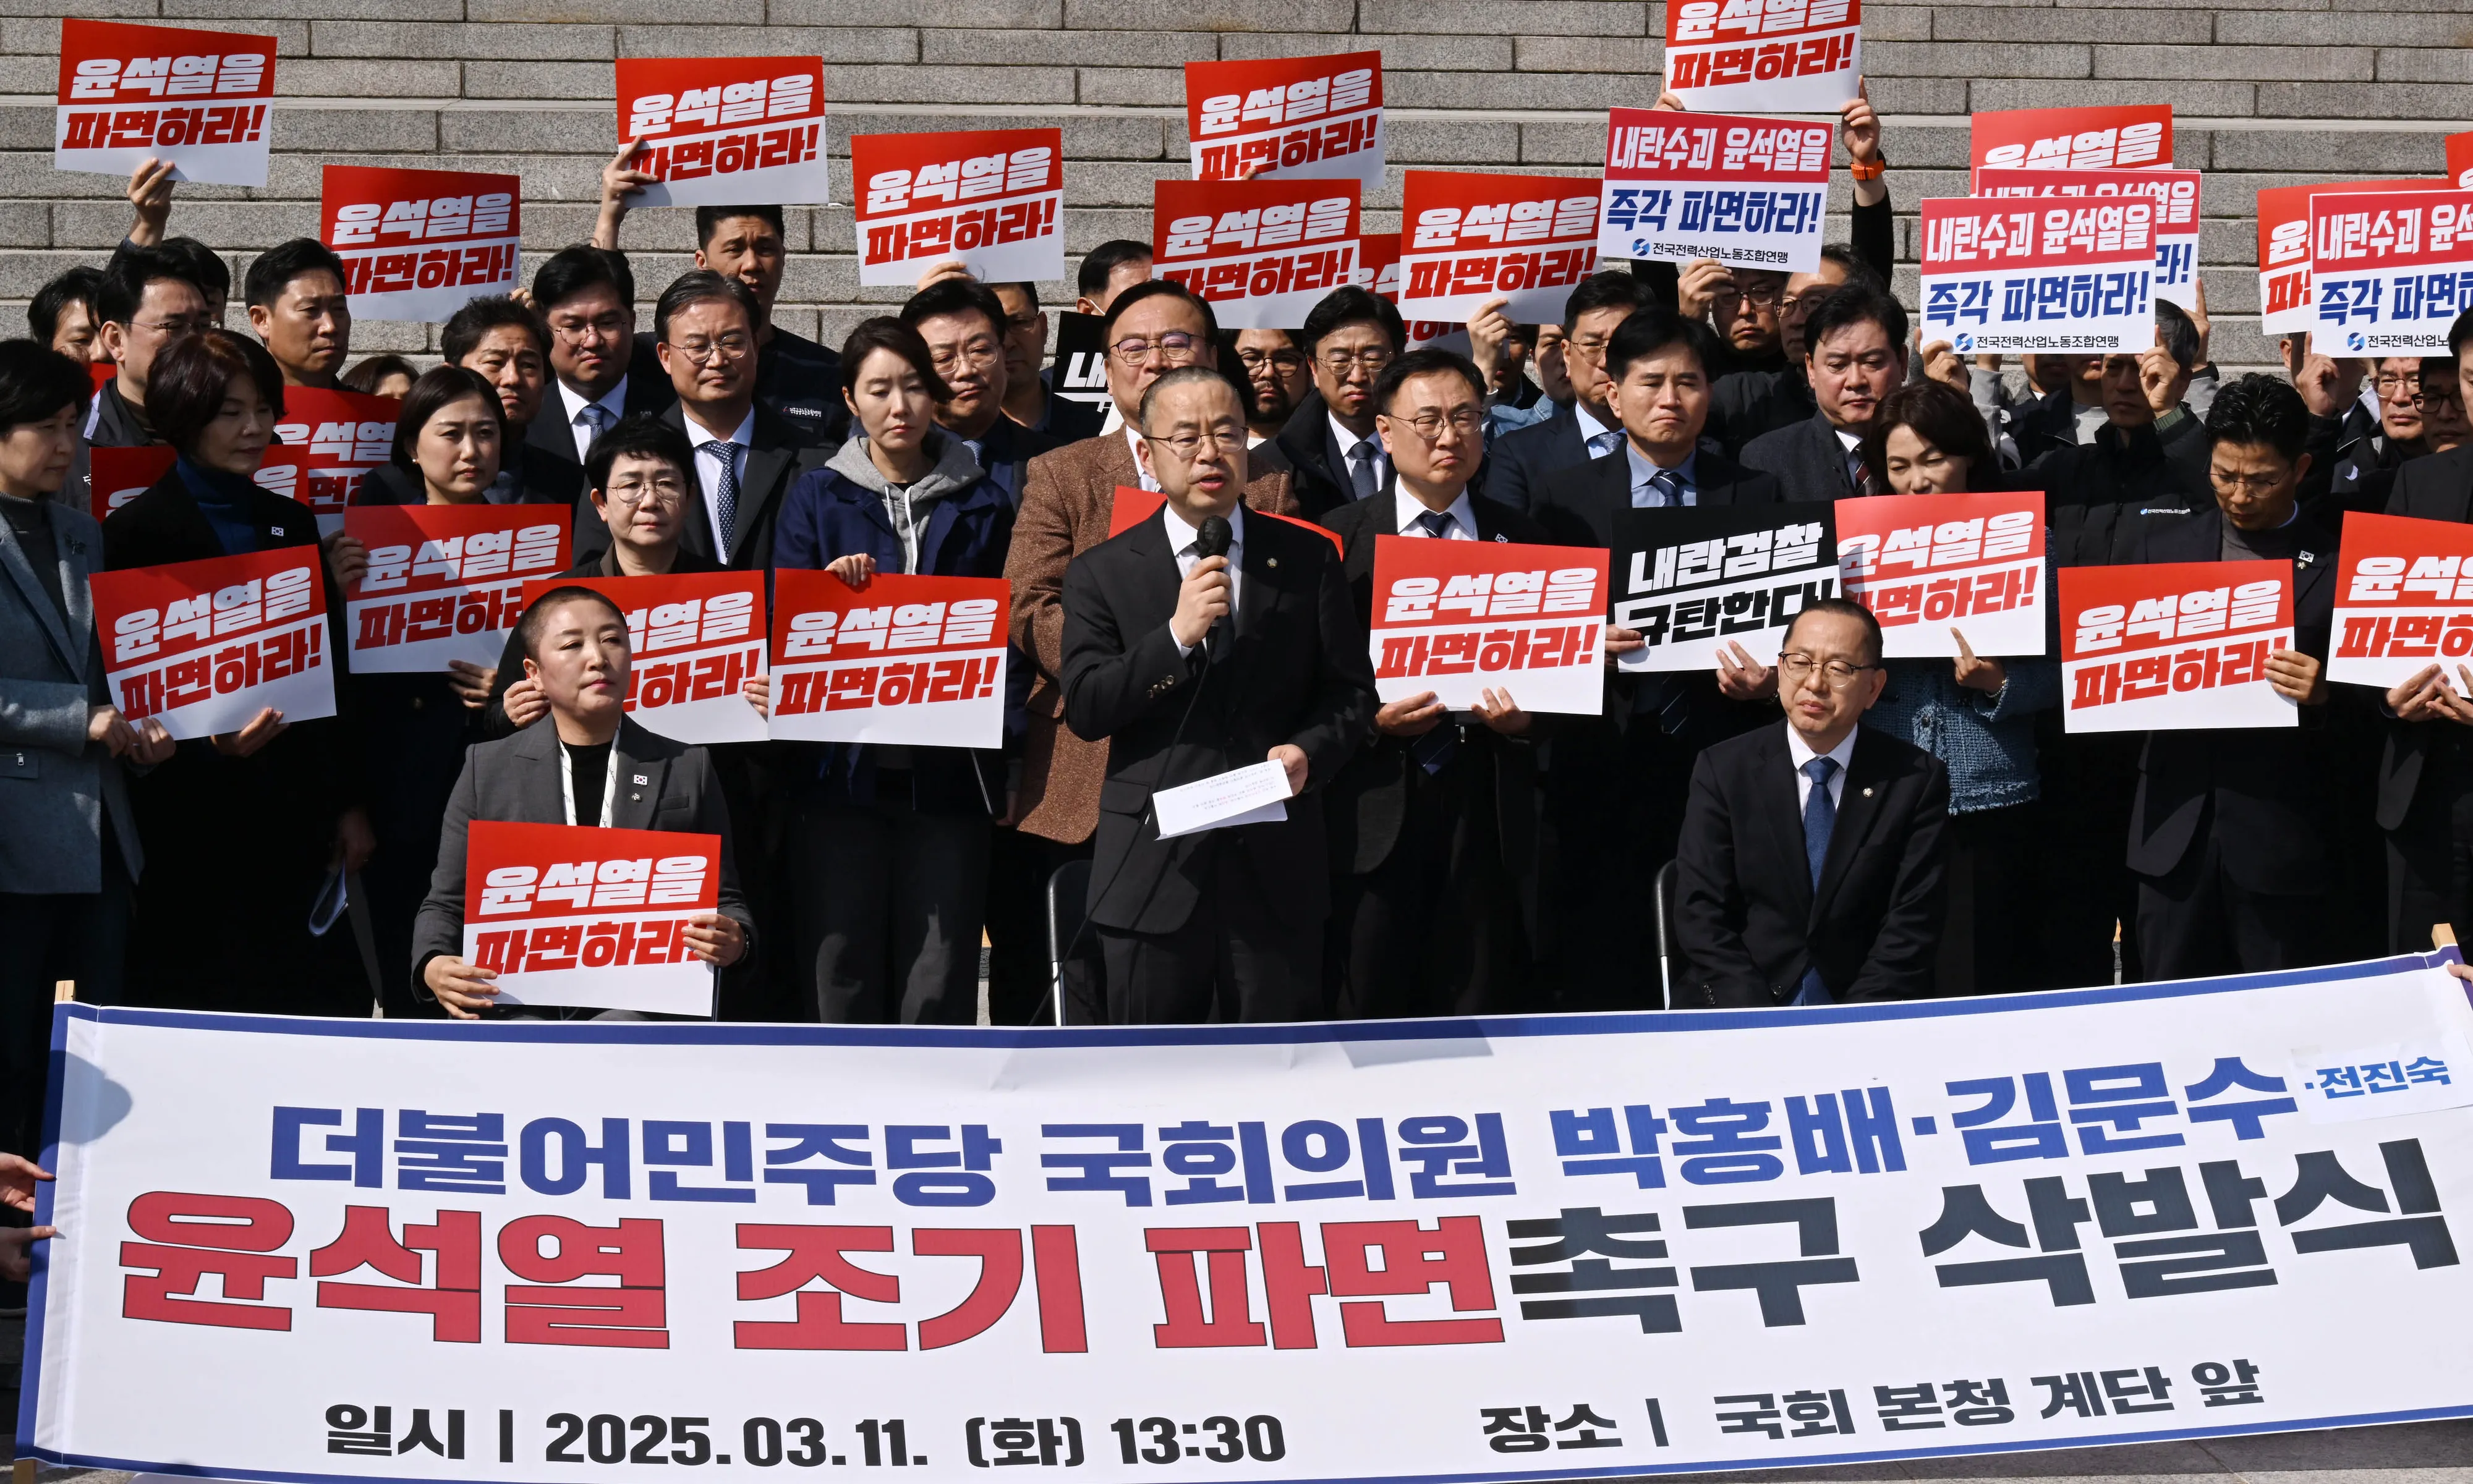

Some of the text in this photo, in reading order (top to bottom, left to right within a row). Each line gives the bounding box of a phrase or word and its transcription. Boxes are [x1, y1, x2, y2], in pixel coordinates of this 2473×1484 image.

[70, 54, 266, 99] 윤석열을
[1670, 33, 1855, 89] 파면하라!
[62, 104, 266, 150] 파면하라!
[629, 74, 814, 137] 윤석열을
[1199, 68, 1373, 135] 윤석열을
[631, 124, 819, 182] 파면하라!
[1199, 114, 1377, 180] 파면하라!
[1611, 125, 1828, 172] 내란수괴 윤석열을
[866, 146, 1052, 214] 윤석열을
[2095, 180, 2195, 223] 열을
[331, 193, 513, 245] 윤석열을
[865, 197, 1057, 266] 파면하라!
[1164, 197, 1351, 257] 윤석열을
[1413, 196, 1599, 248] 윤석열을
[1607, 189, 1821, 235] 즉각 파면하라!
[1926, 204, 2151, 262] 내란수괴 윤석열을
[2317, 208, 2422, 260] 내란수괴
[2430, 204, 2473, 251] 윤석
[1404, 248, 1594, 299] 파면하라!
[1653, 242, 1789, 263] 전국전력산업노동조합연맹
[1926, 271, 2149, 327] 즉각 파면하라!
[2319, 278, 2383, 326] 즉각
[1976, 335, 2119, 349] 전국전력산업노동조합연맹
[2368, 334, 2448, 347] 전국전력산업노
[273, 422, 396, 461] 석열
[360, 524, 560, 592] 윤석열을
[1627, 522, 1823, 595] 내란검찰
[1837, 511, 2034, 579] 윤석열을
[1384, 567, 1598, 622] 윤석열을
[2348, 556, 2473, 601] 윤석
[114, 566, 312, 664] 윤석열을
[354, 587, 523, 650] 파면하
[783, 599, 998, 659] 윤석열을
[2074, 580, 2281, 654] 윤석열을
[2336, 614, 2473, 658] 파면하
[120, 622, 322, 723] 파면하라!
[623, 648, 760, 713] 하라!
[1375, 624, 1600, 679] 파면하라!
[776, 656, 1000, 718] 파면하라!
[479, 855, 708, 916] 윤석열을
[270, 1105, 1003, 1208] 더불어민주당
[1041, 1112, 1517, 1207] 국회의원
[1549, 1056, 2300, 1190] 박홍배·김문수
[119, 1190, 671, 1350] 윤석열
[734, 1223, 1089, 1354] 조기
[1918, 1137, 2461, 1308] 삭발식
[325, 1403, 466, 1461] 일시
[545, 1412, 929, 1467] 2025.03.11.
[966, 1414, 1084, 1467] (화)
[1111, 1413, 1287, 1465] 13:30
[1481, 1402, 1622, 1454] 장소
[1715, 1388, 1857, 1440] 국회
[1873, 1378, 2017, 1431] 본청
[2030, 1365, 2176, 1420] 계단
[2190, 1358, 2265, 1409] 앞
